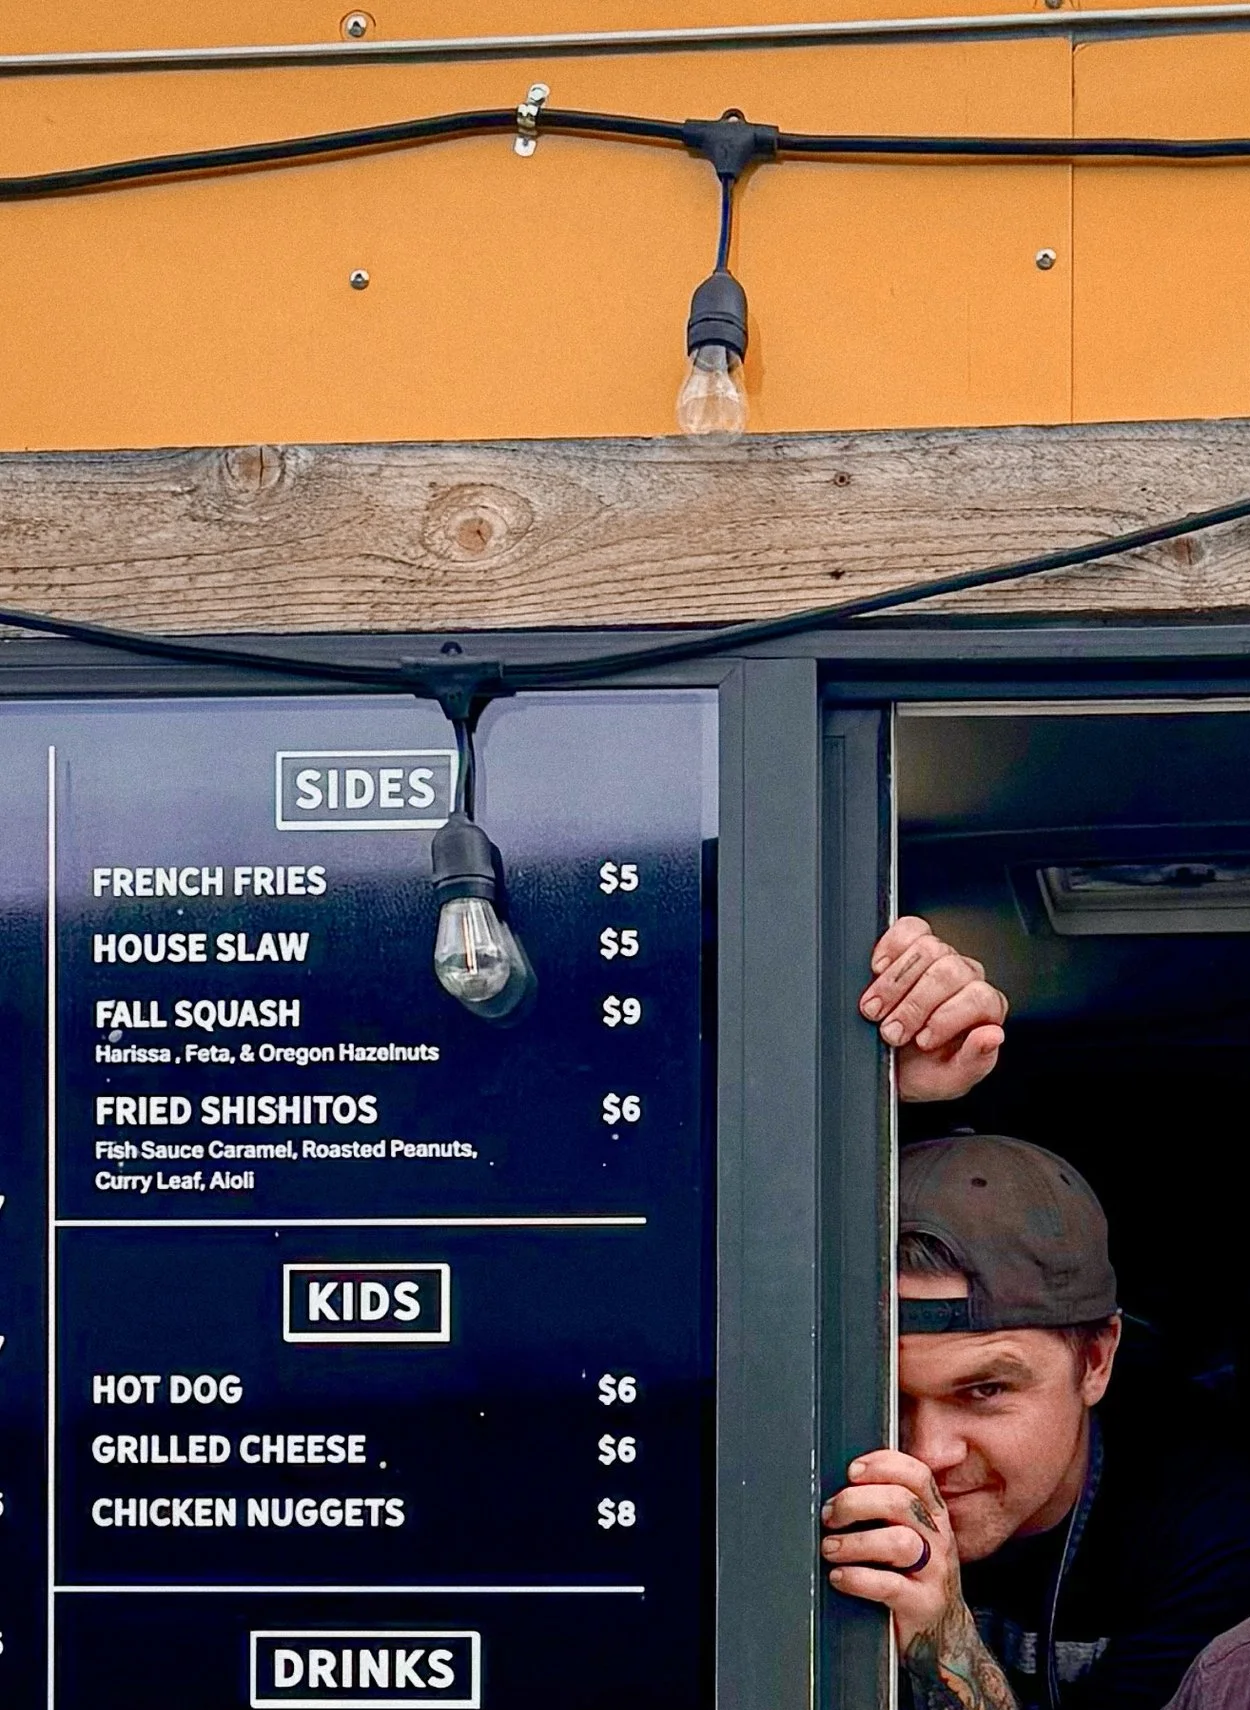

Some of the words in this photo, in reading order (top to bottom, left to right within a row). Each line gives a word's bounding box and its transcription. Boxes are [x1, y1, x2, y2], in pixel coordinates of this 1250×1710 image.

[295, 768, 436, 810] SIDES
[93, 867, 225, 898] FRENCH
[234, 866, 328, 897] FRIES
[600, 862, 640, 895] $5
[93, 934, 208, 964] HOUSE
[216, 933, 311, 963] SLAW
[600, 928, 640, 961] $5
[96, 1000, 168, 1029] FALL
[174, 999, 301, 1030] SQUASH
[603, 996, 642, 1028] $9
[185, 1043, 237, 1066] Feta,
[239, 1044, 256, 1064] &
[259, 1043, 336, 1067] Oregon
[338, 1043, 441, 1063] Hazelnuts
[96, 1097, 193, 1126] FRIED
[201, 1095, 379, 1126] SHISHITOS
[602, 1092, 642, 1126] $6
[95, 1141, 139, 1161] Fish
[141, 1141, 206, 1161] Sauce
[208, 1140, 299, 1161] Caramel,
[302, 1140, 387, 1161] Roasted
[389, 1140, 479, 1161] Peanuts,
[95, 1172, 154, 1195] Curry
[156, 1171, 207, 1193] Leaf,
[209, 1171, 256, 1191] Aioli
[308, 1282, 422, 1322] KIDS
[93, 1376, 162, 1405] HOT
[170, 1375, 244, 1405] DOG
[598, 1374, 638, 1407] $6
[91, 1435, 232, 1465] GRILLED
[240, 1435, 367, 1465] CHEESE
[598, 1434, 637, 1467] $6
[91, 1498, 237, 1528] CHICKEN
[247, 1498, 406, 1528] NUGGETS
[598, 1498, 637, 1531] $8
[274, 1650, 456, 1690] DRINKS
